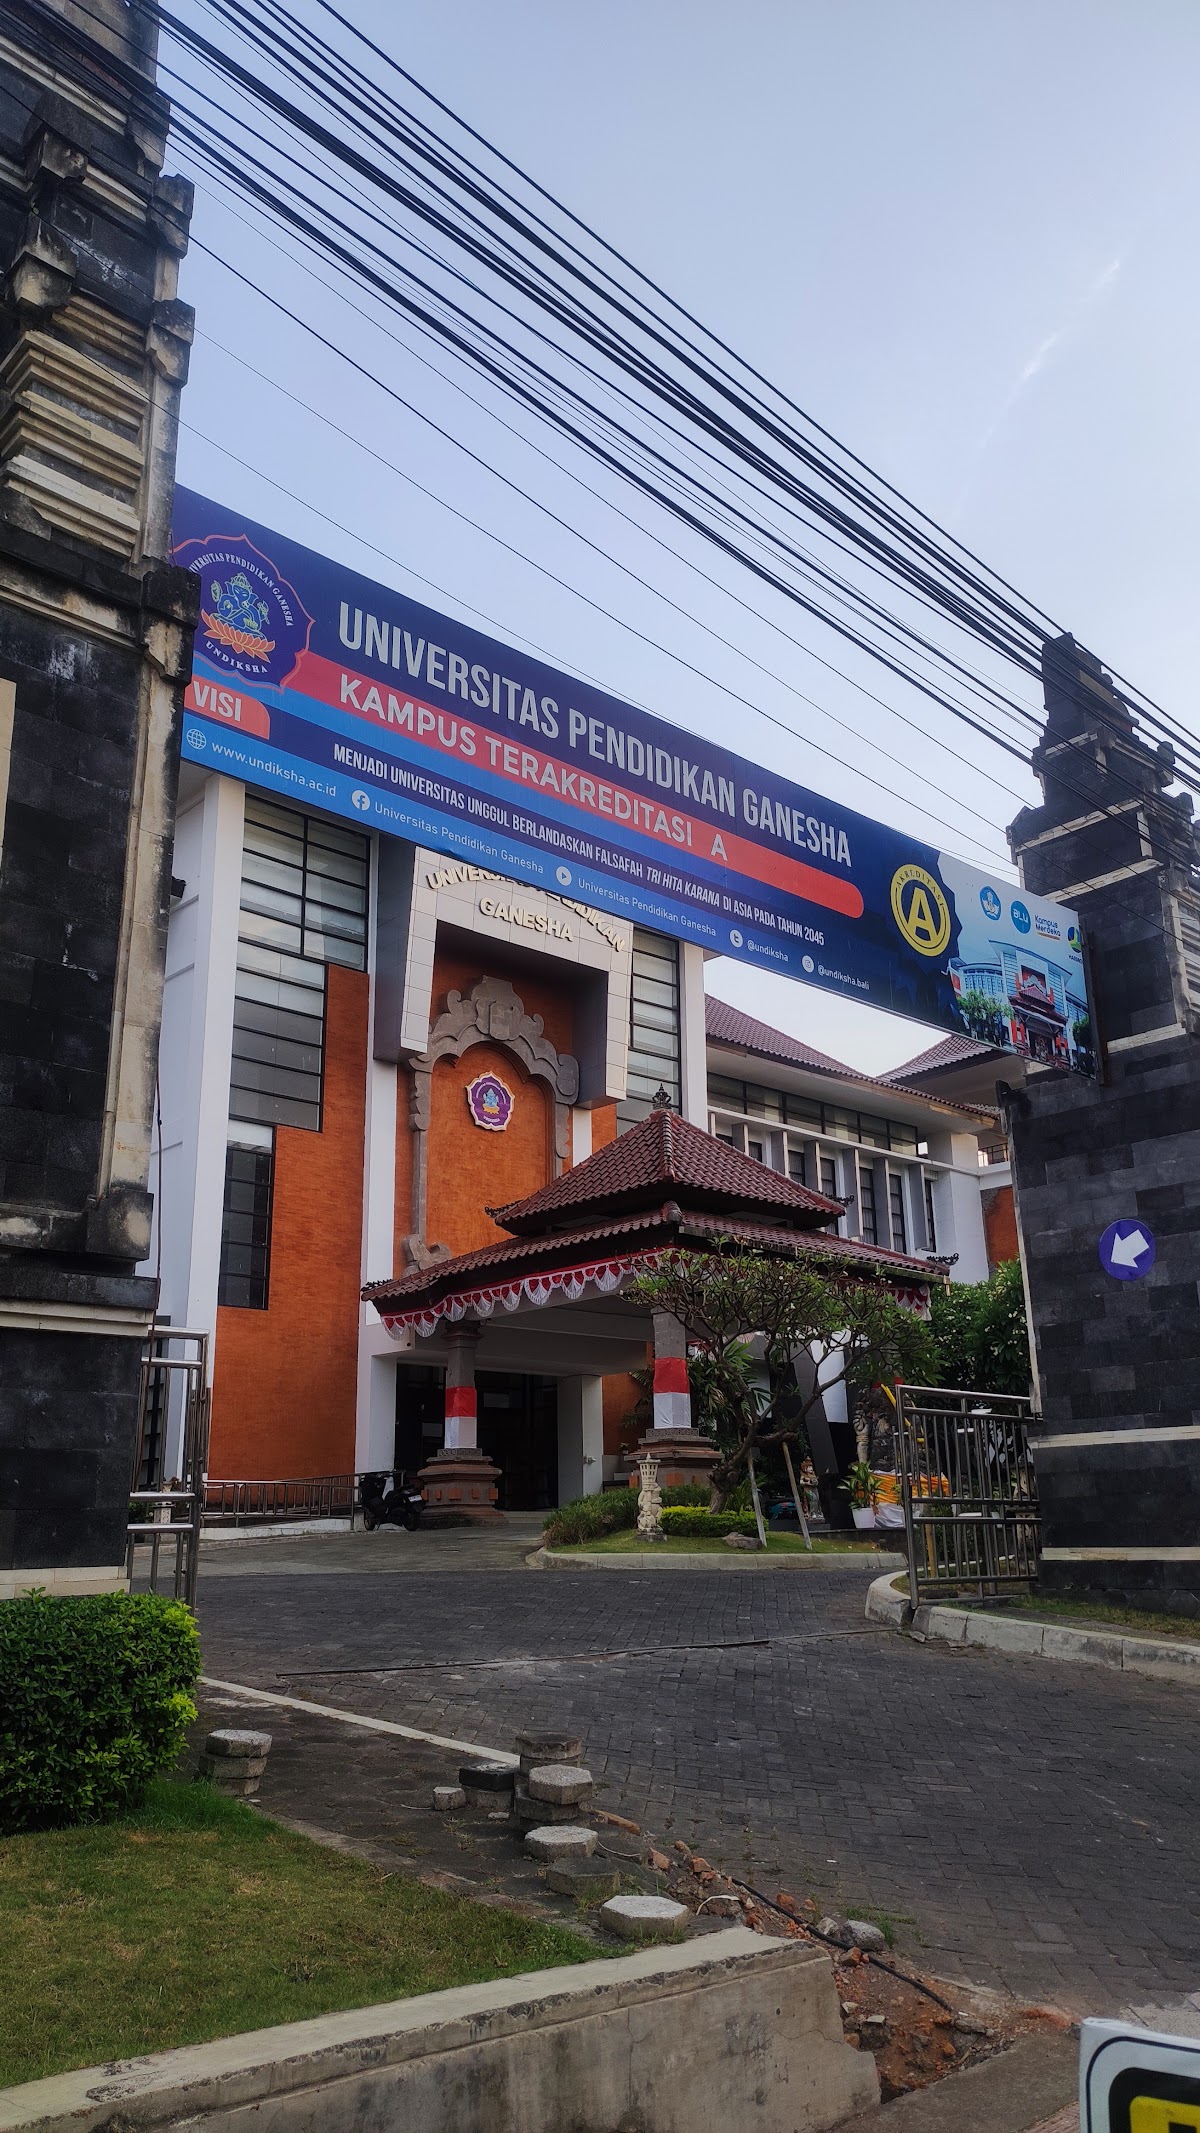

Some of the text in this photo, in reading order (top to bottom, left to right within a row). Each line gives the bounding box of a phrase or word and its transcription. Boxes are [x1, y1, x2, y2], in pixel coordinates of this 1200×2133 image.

[225, 553, 274, 589] PENDIDIKAN
[272, 587, 294, 626] GANESHA
[205, 640, 268, 674] UNDIKSHA
[193, 680, 242, 722] VISI
[339, 600, 852, 868] UNIVERSITAS PENDIDIKAN GANESHA
[211, 742, 337, 798] www.undiksha.ac.id
[340, 673, 729, 861] KAMPUS TERAKREDITASI A
[333, 743, 825, 947] MENJADI UNIVERSITAS UNGGUL BERLANDASKAN FALSAFAH TRI HITA KARANA DI ASIA PADA TAHUN 2045
[374, 800, 545, 875] Universitas Pendidikan Ganesha
[578, 877, 717, 938] Universitas Pendidikan Ganesha
[896, 869, 944, 907] AKREDITASI
[479, 897, 574, 942] GANESHA
[1012, 907, 1029, 924] BLU
[1034, 914, 1059, 930] Kampus
[1035, 923, 1061, 937] Merdeka
[747, 939, 789, 963] @undiksha
[817, 964, 870, 991] @undiksha.bali
